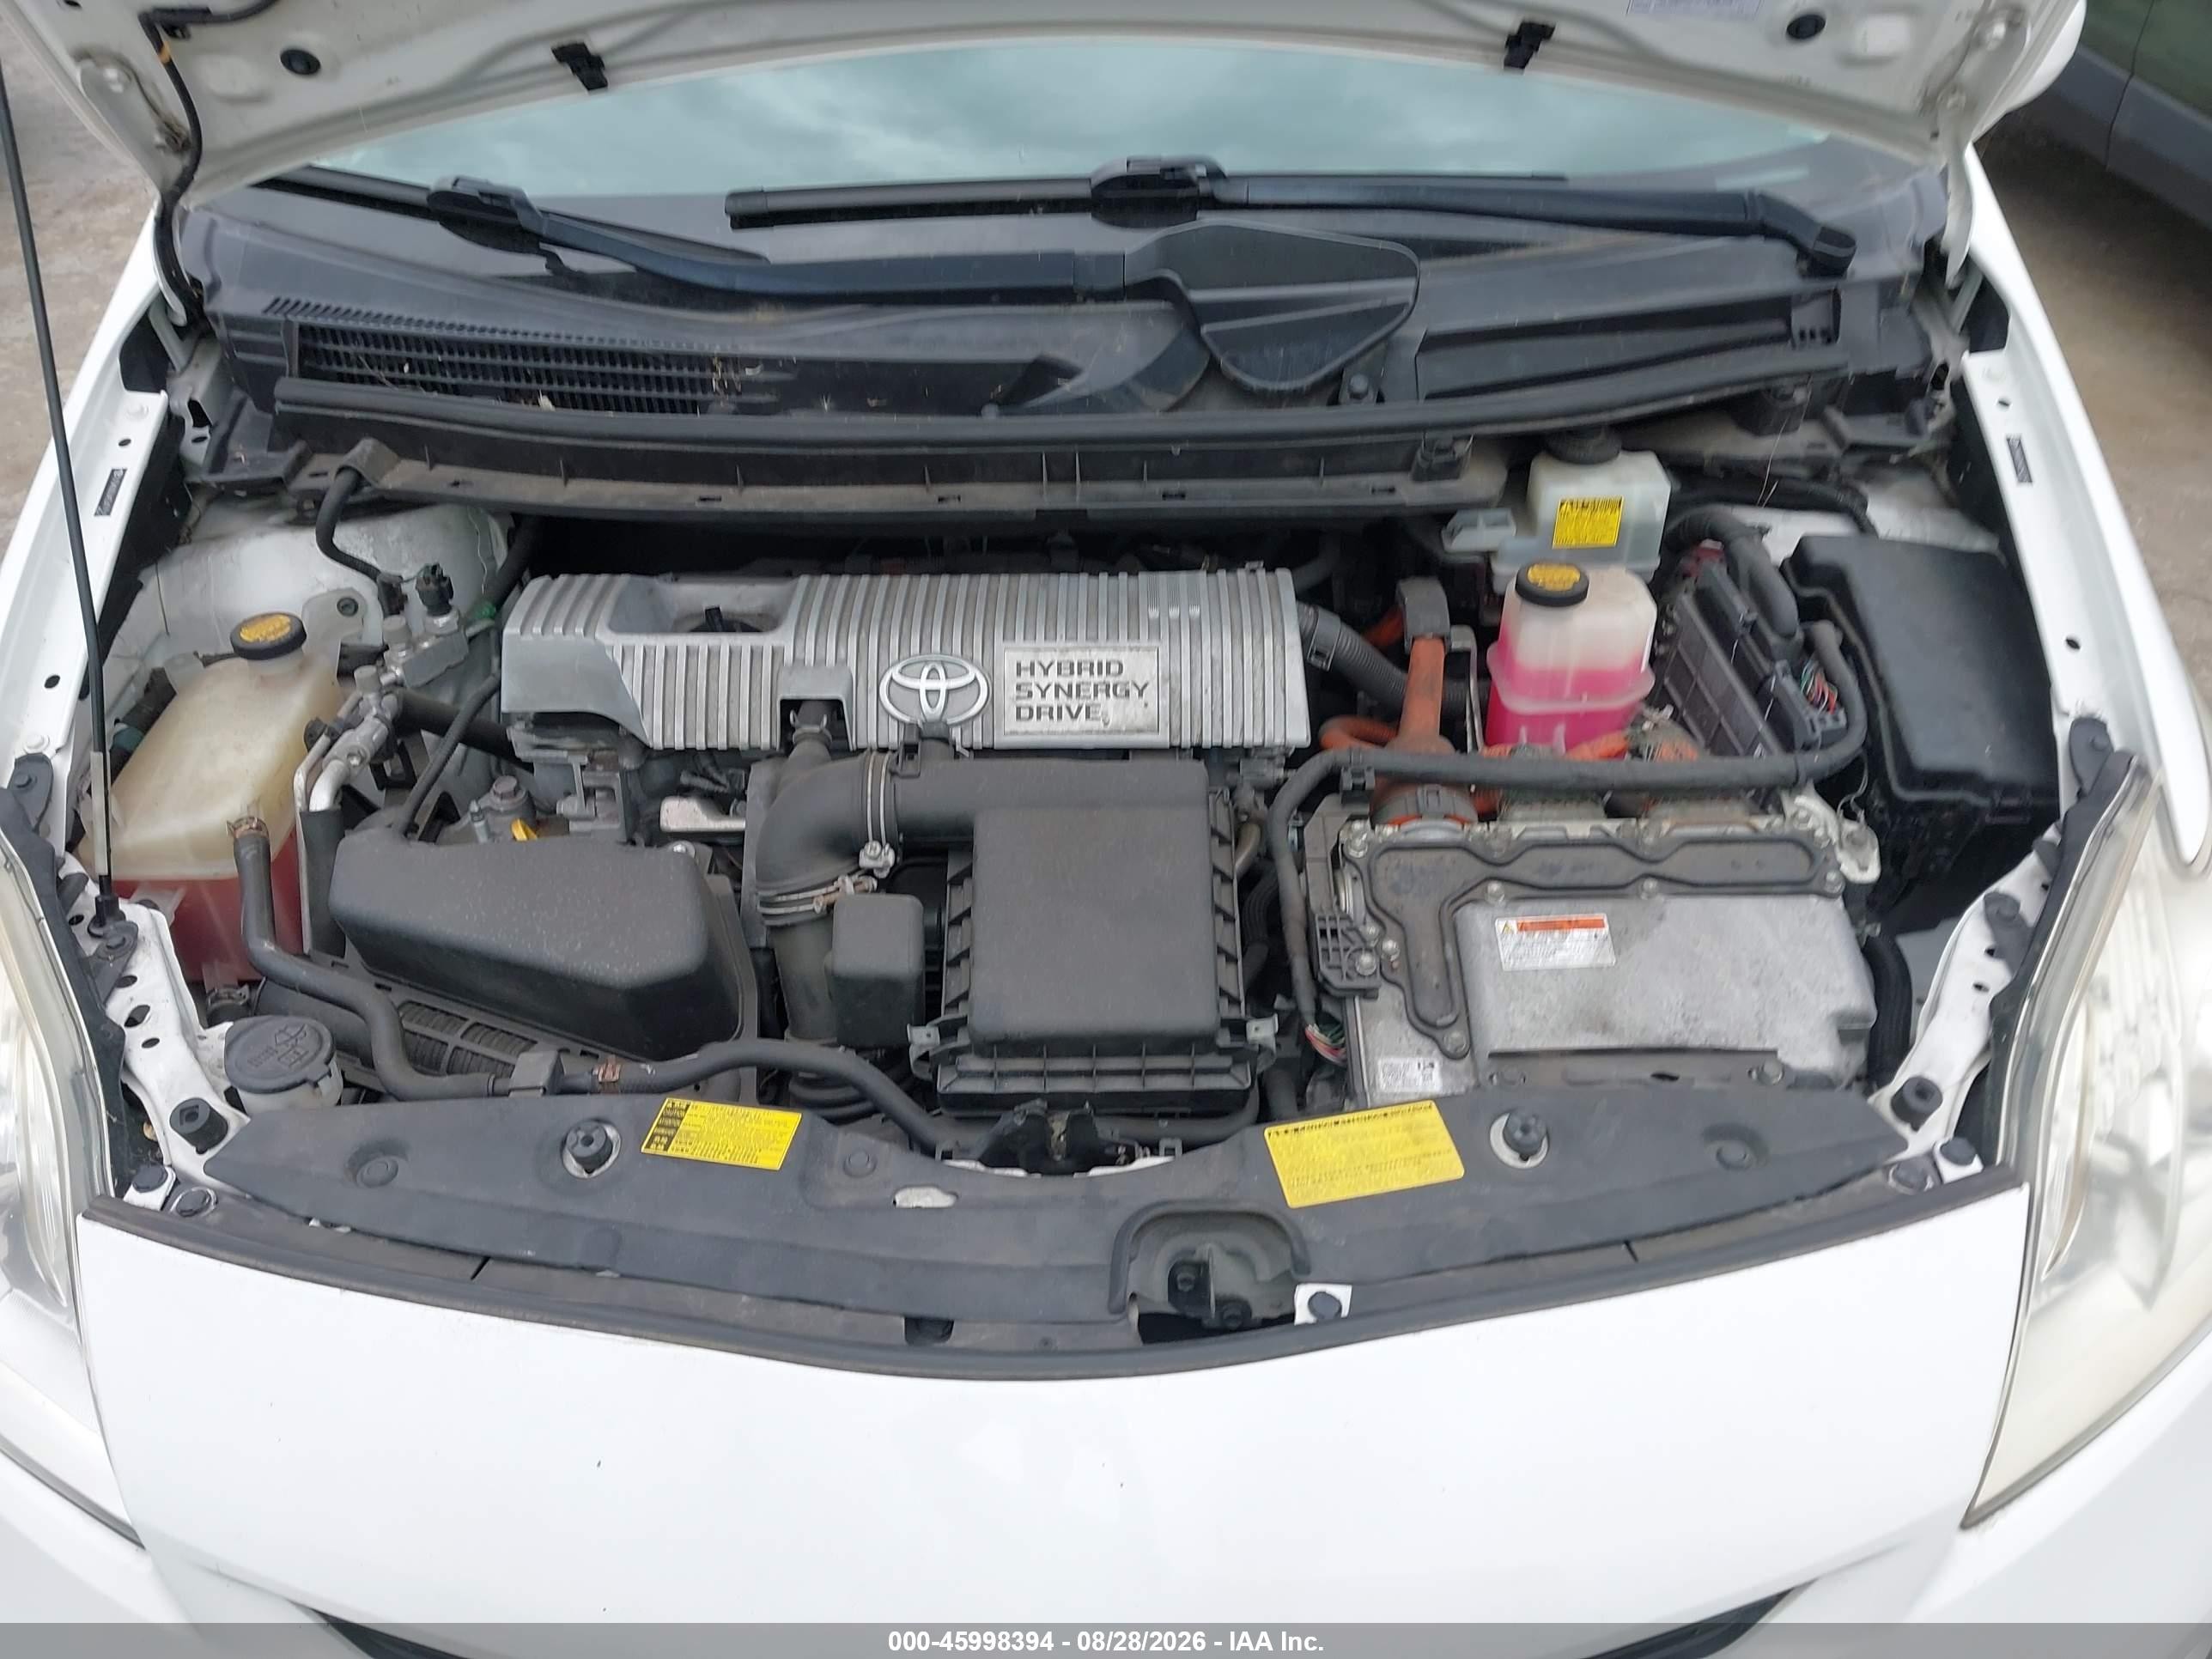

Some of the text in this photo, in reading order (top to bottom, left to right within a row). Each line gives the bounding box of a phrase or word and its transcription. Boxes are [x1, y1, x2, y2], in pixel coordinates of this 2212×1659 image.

[1015, 659, 1124, 678] HYBRID
[1015, 681, 1149, 701] SYNERGY
[1015, 703, 1102, 722] DRIVE
